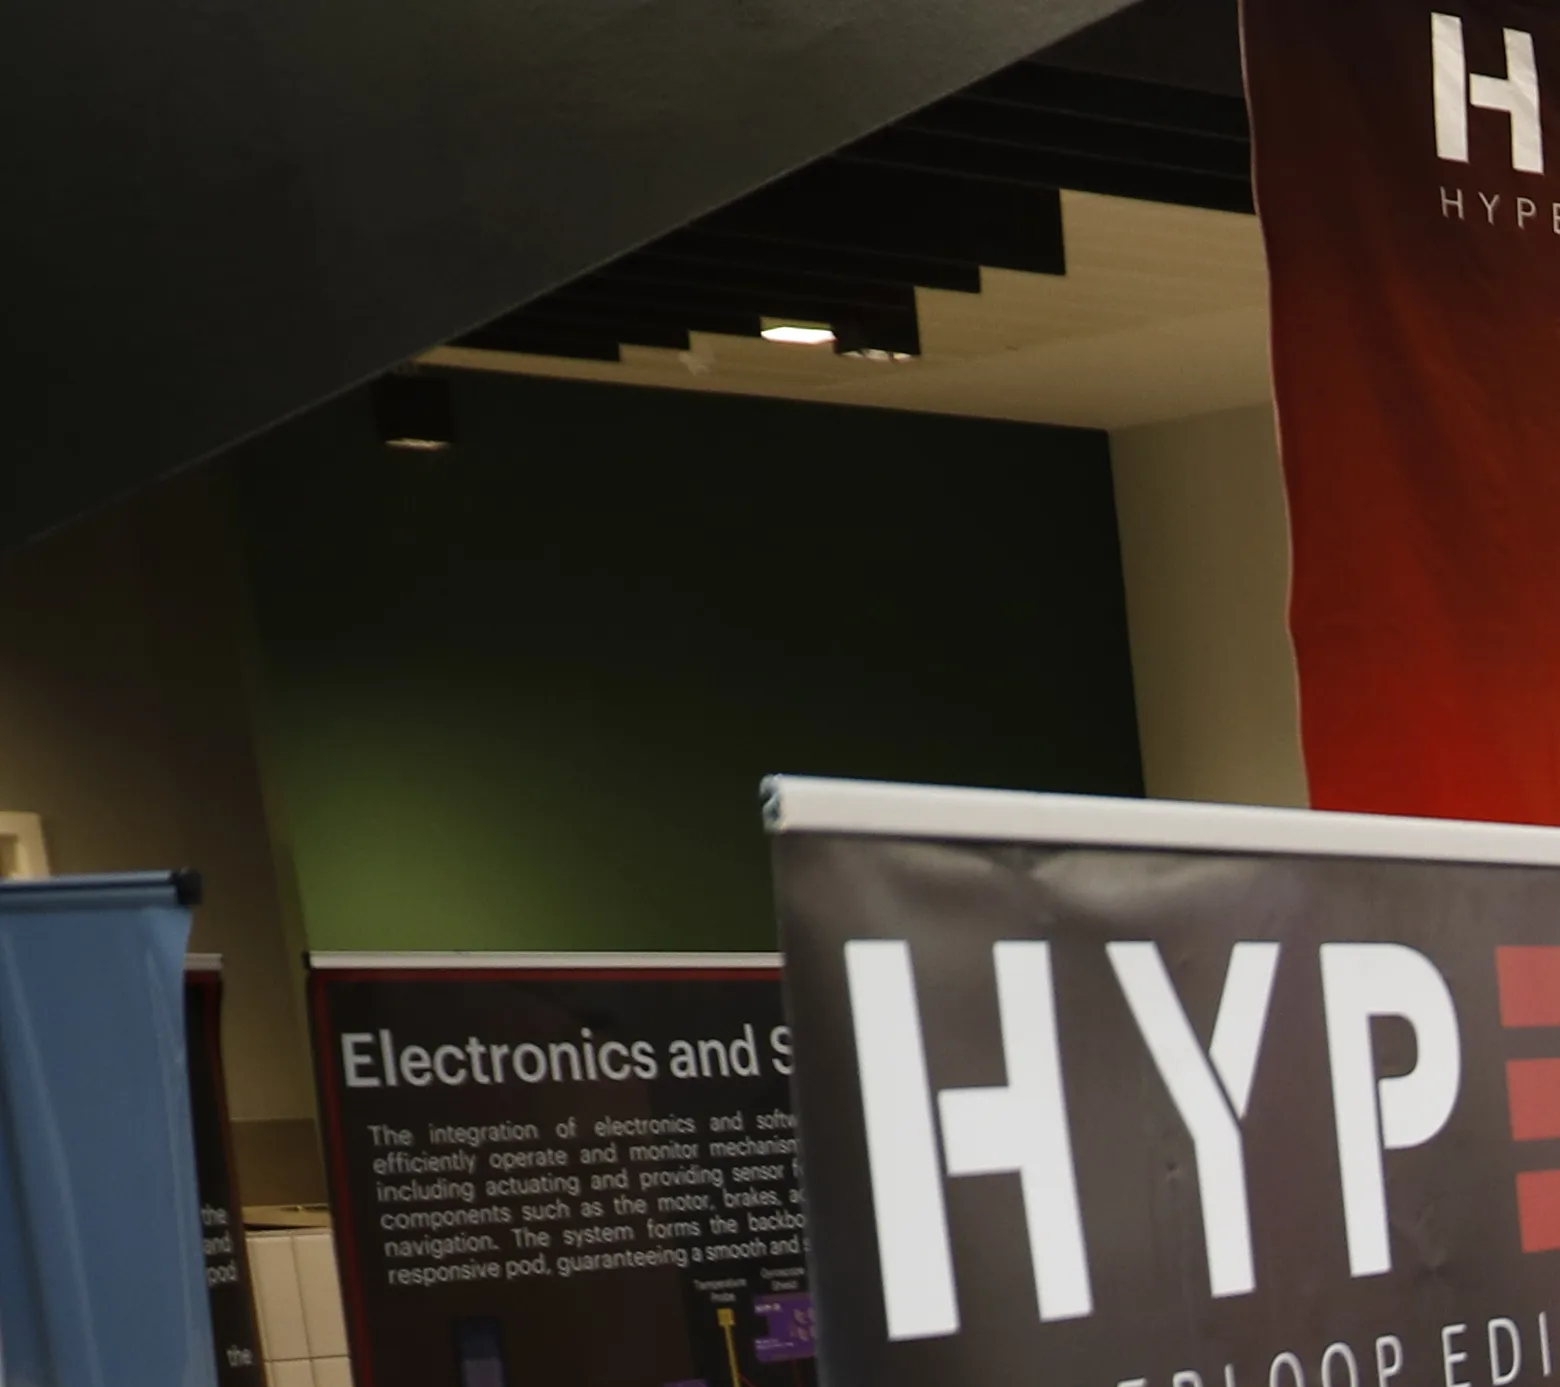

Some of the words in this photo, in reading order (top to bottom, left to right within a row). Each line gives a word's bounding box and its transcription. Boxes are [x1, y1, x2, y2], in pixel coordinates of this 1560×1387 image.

[340, 1026, 659, 1089] Electronics
[669, 1022, 759, 1078] and
[368, 1124, 414, 1147] The
[428, 1120, 539, 1146] integration
[555, 1119, 578, 1140] of
[594, 1115, 697, 1138] electronics
[710, 1111, 744, 1132] and
[373, 1150, 477, 1175] efficiently
[489, 1147, 569, 1171] operate
[580, 1145, 618, 1165] and
[630, 1141, 699, 1162] monitor
